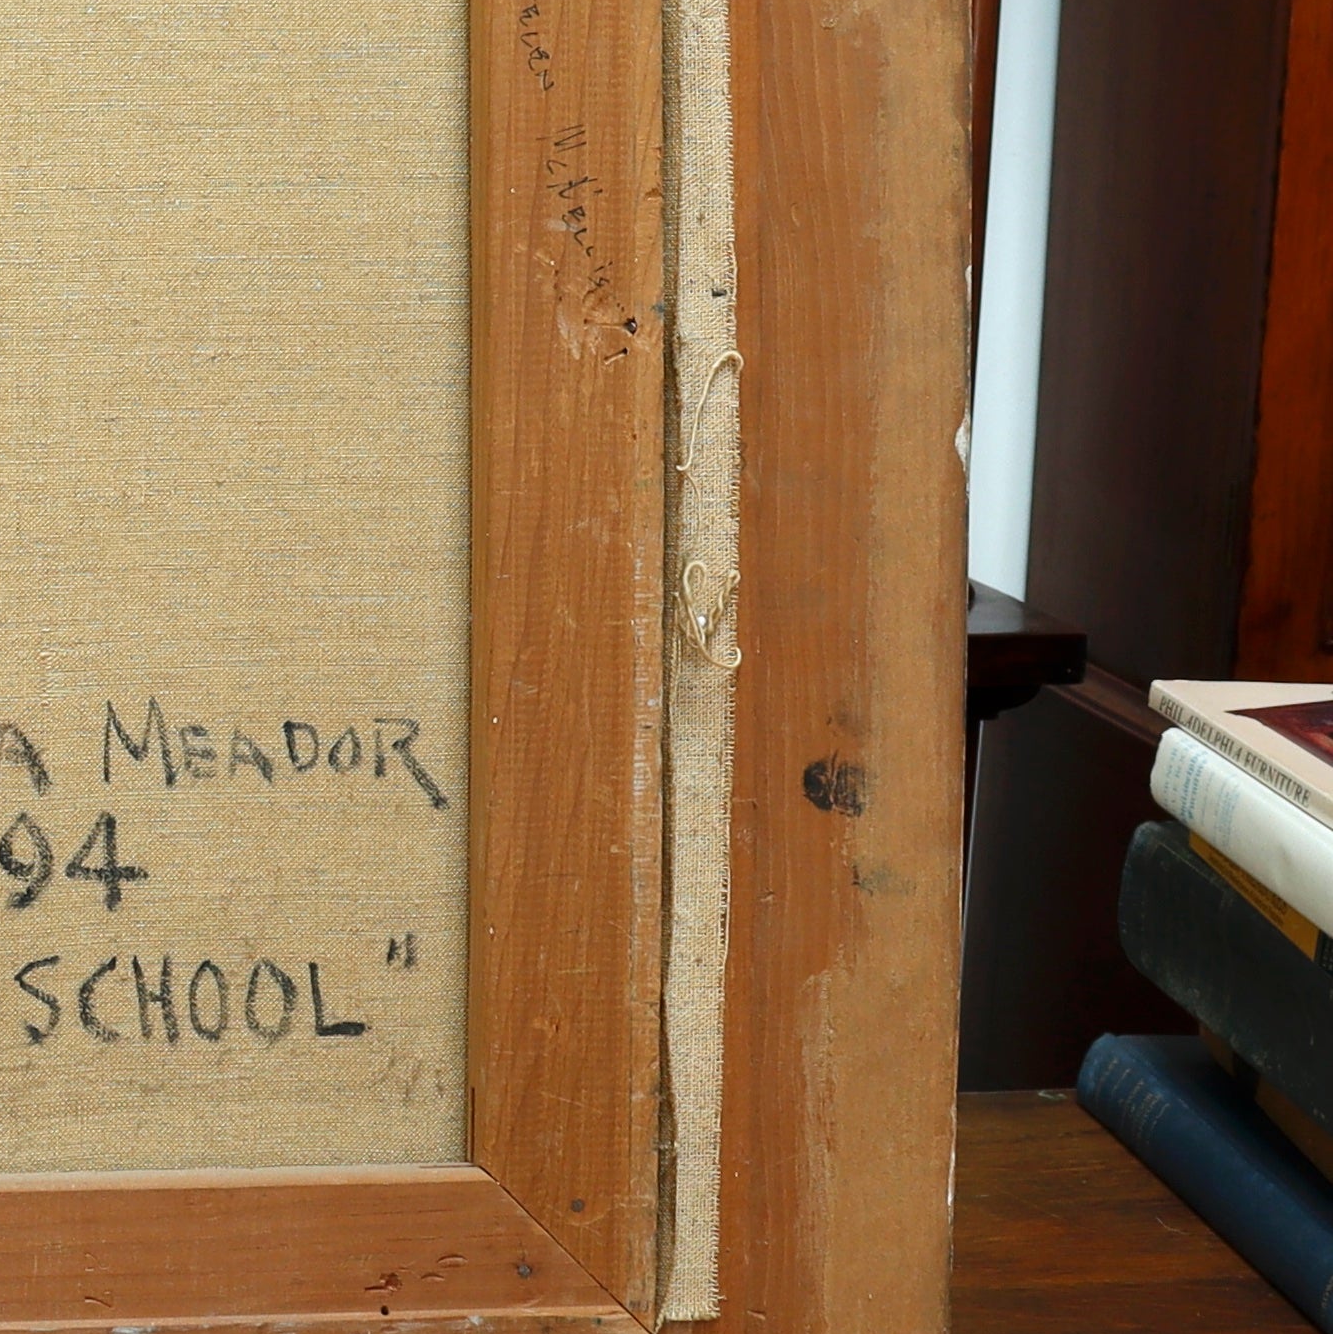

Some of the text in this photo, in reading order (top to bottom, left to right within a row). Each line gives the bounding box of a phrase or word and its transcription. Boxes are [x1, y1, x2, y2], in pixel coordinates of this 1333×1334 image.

[101, 693, 451, 810] MEADOR
[1158, 695, 1242, 761] PHILADELPHIA
[1244, 752, 1312, 809] FURNITURE
